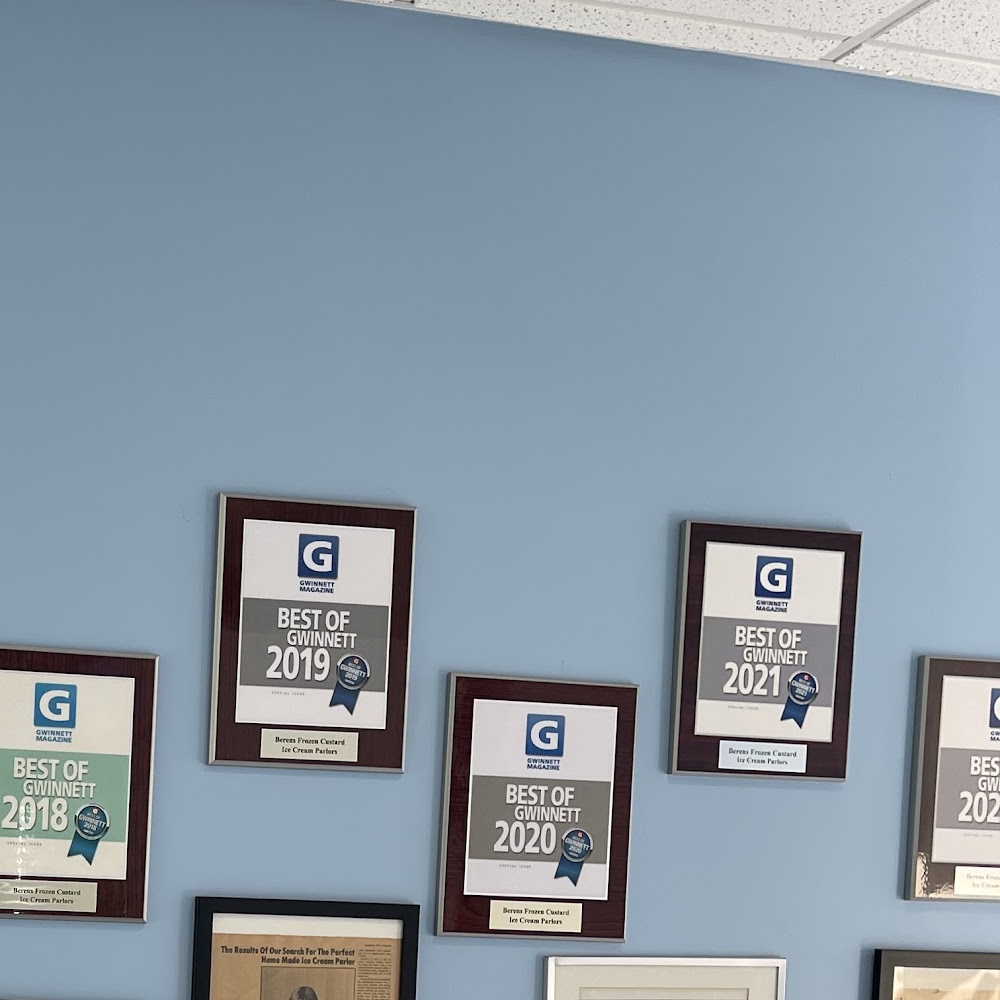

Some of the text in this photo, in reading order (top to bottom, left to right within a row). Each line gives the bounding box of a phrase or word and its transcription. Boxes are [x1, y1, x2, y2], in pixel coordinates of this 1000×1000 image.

[303, 541, 332, 572] G
[760, 563, 787, 592] G
[278, 607, 350, 631] BEST OF
[287, 630, 357, 649] GWINNETT
[735, 626, 801, 649] BEST OF
[266, 645, 330, 681] 2019
[743, 647, 807, 665] GWINNETT
[723, 662, 780, 696] 2021
[39, 690, 70, 721] G
[531, 720, 558, 750] G
[14, 757, 88, 781] BEST OF
[971, 756, 1000, 776] BES
[23, 780, 96, 798] GWINNETT
[506, 784, 574, 806] BEST OF
[1, 795, 68, 831] 2018
[515, 805, 581, 822] GWINNETT
[958, 791, 1000, 823] 202
[494, 820, 556, 854] 2020
[282, 947, 304, 955] Search
[313, 957, 333, 965] Cream
